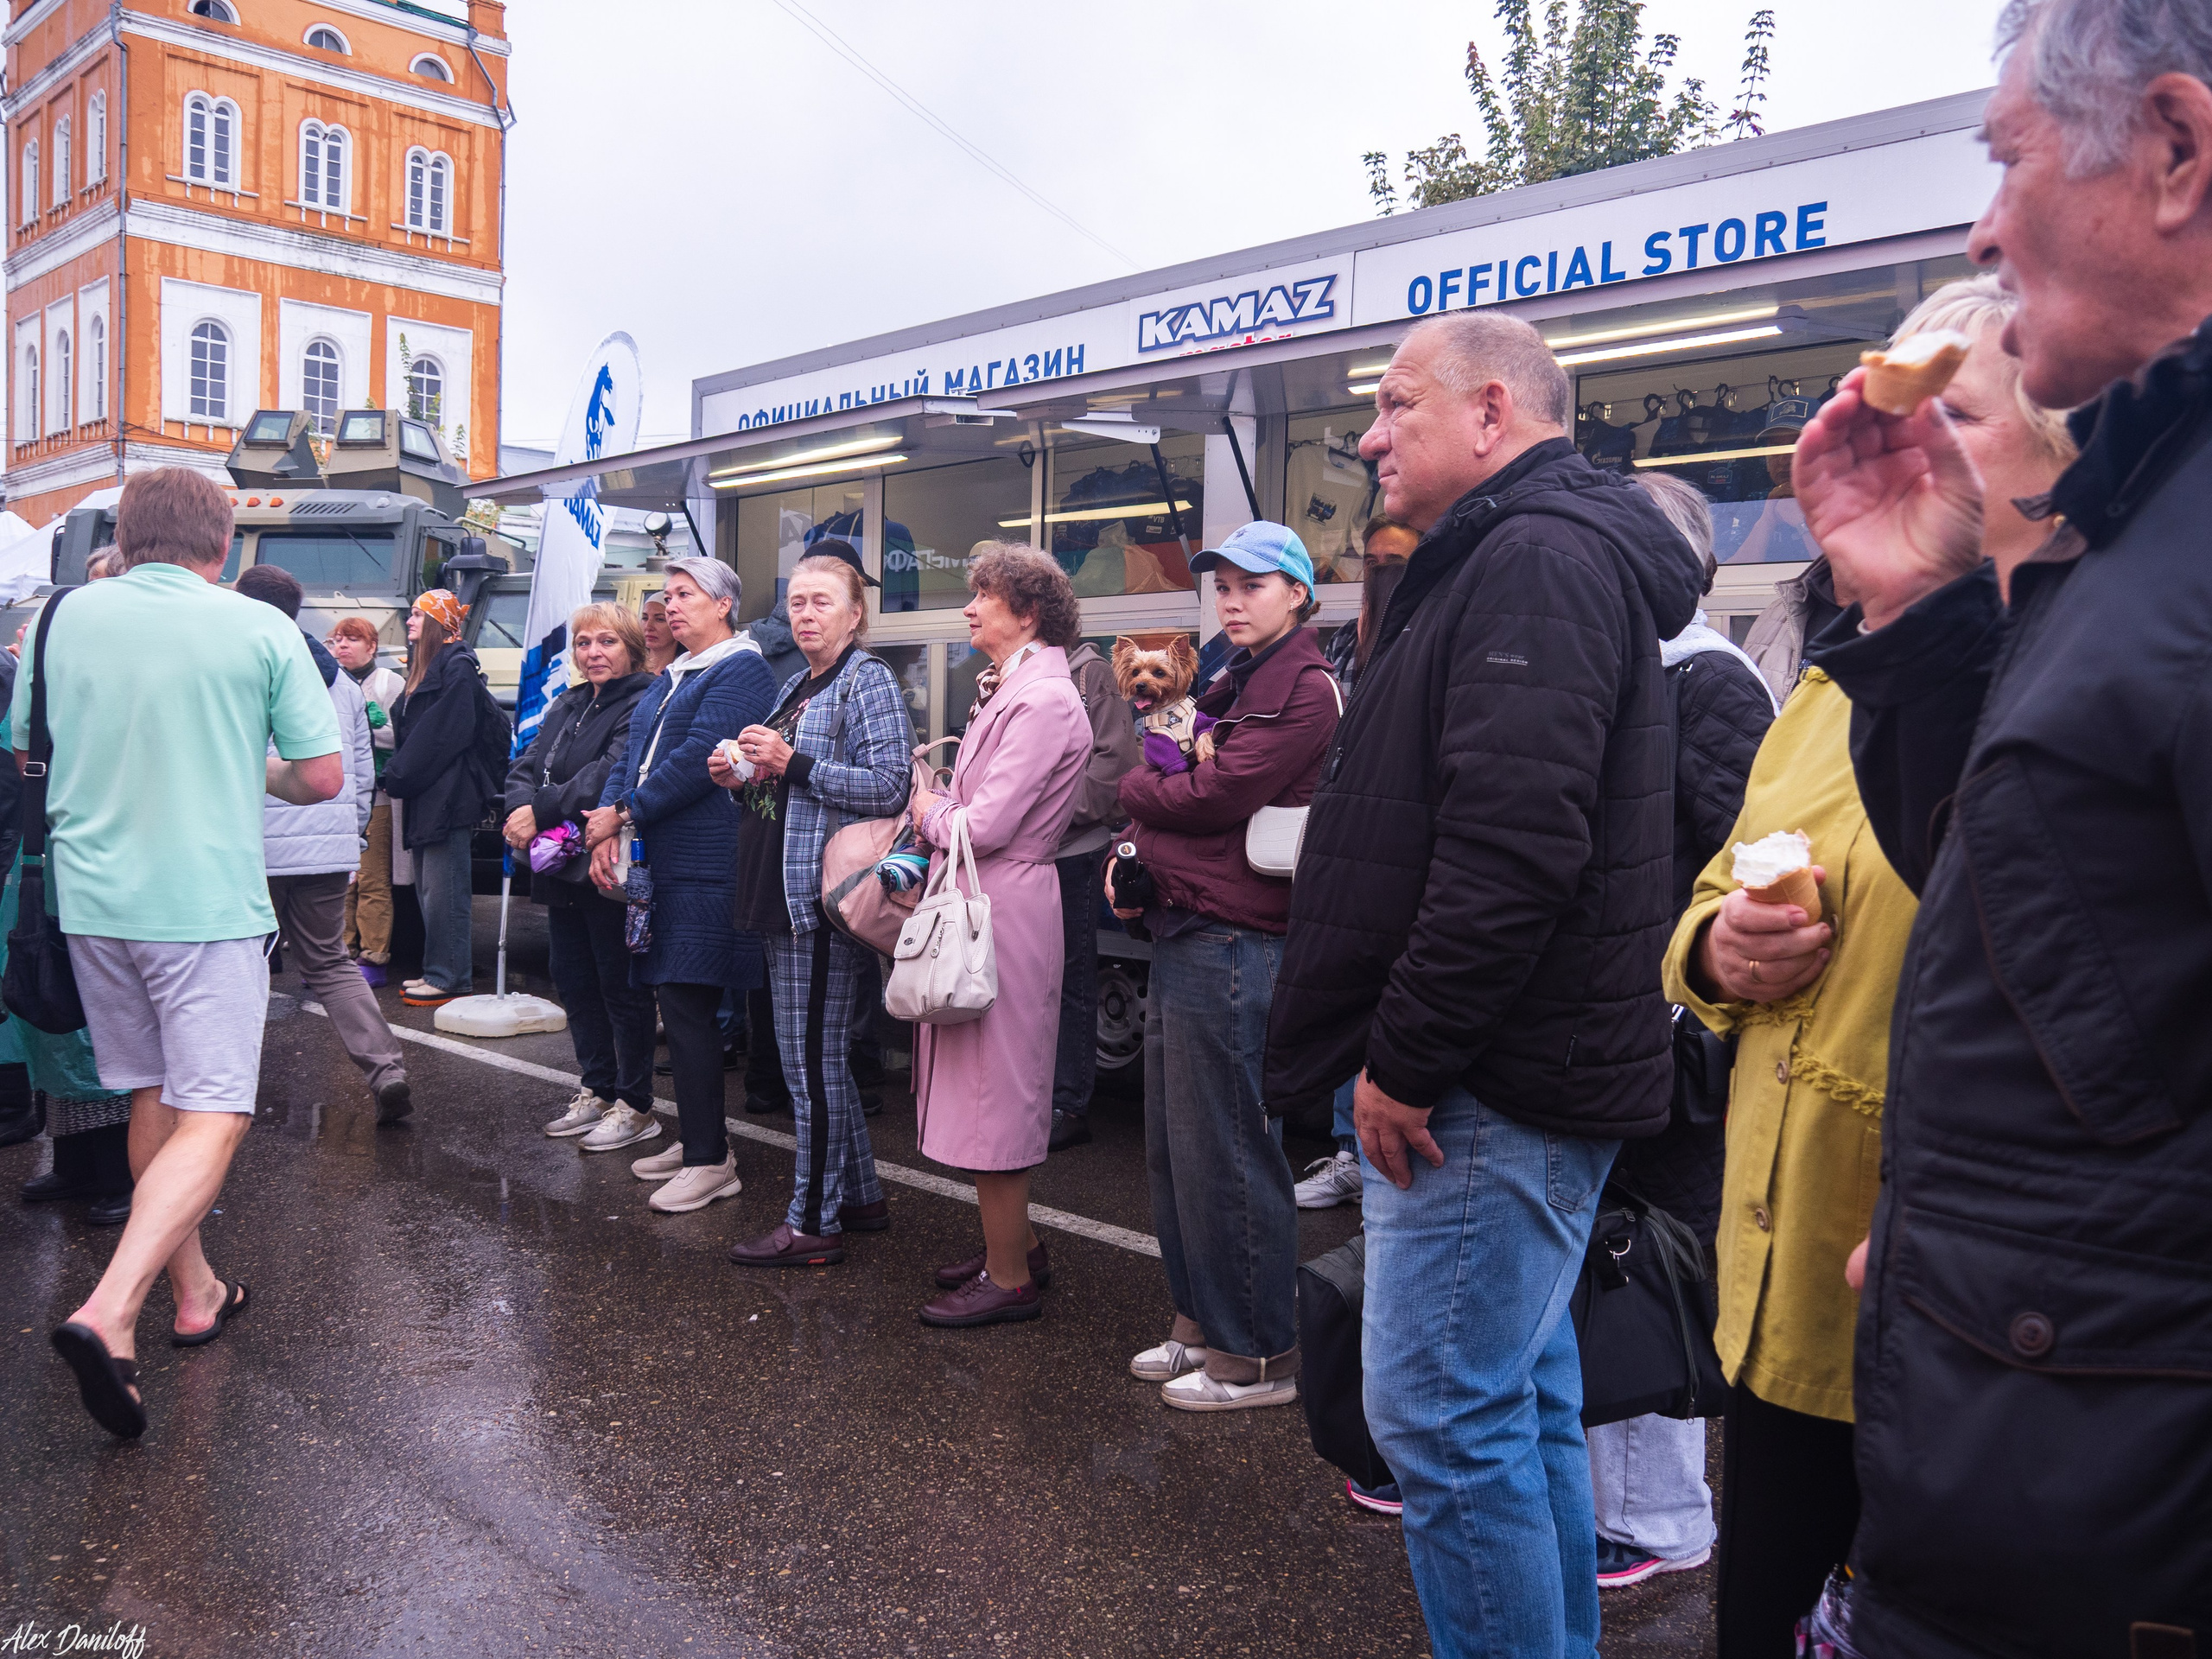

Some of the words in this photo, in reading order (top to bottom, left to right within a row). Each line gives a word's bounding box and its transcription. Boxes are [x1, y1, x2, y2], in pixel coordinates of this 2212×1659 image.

[1408, 240, 1626, 315] OFFICIAL
[1642, 200, 1828, 276] STORE
[1138, 273, 1338, 353] KAMAZ
[944, 343, 1085, 396] МАГАЗИН
